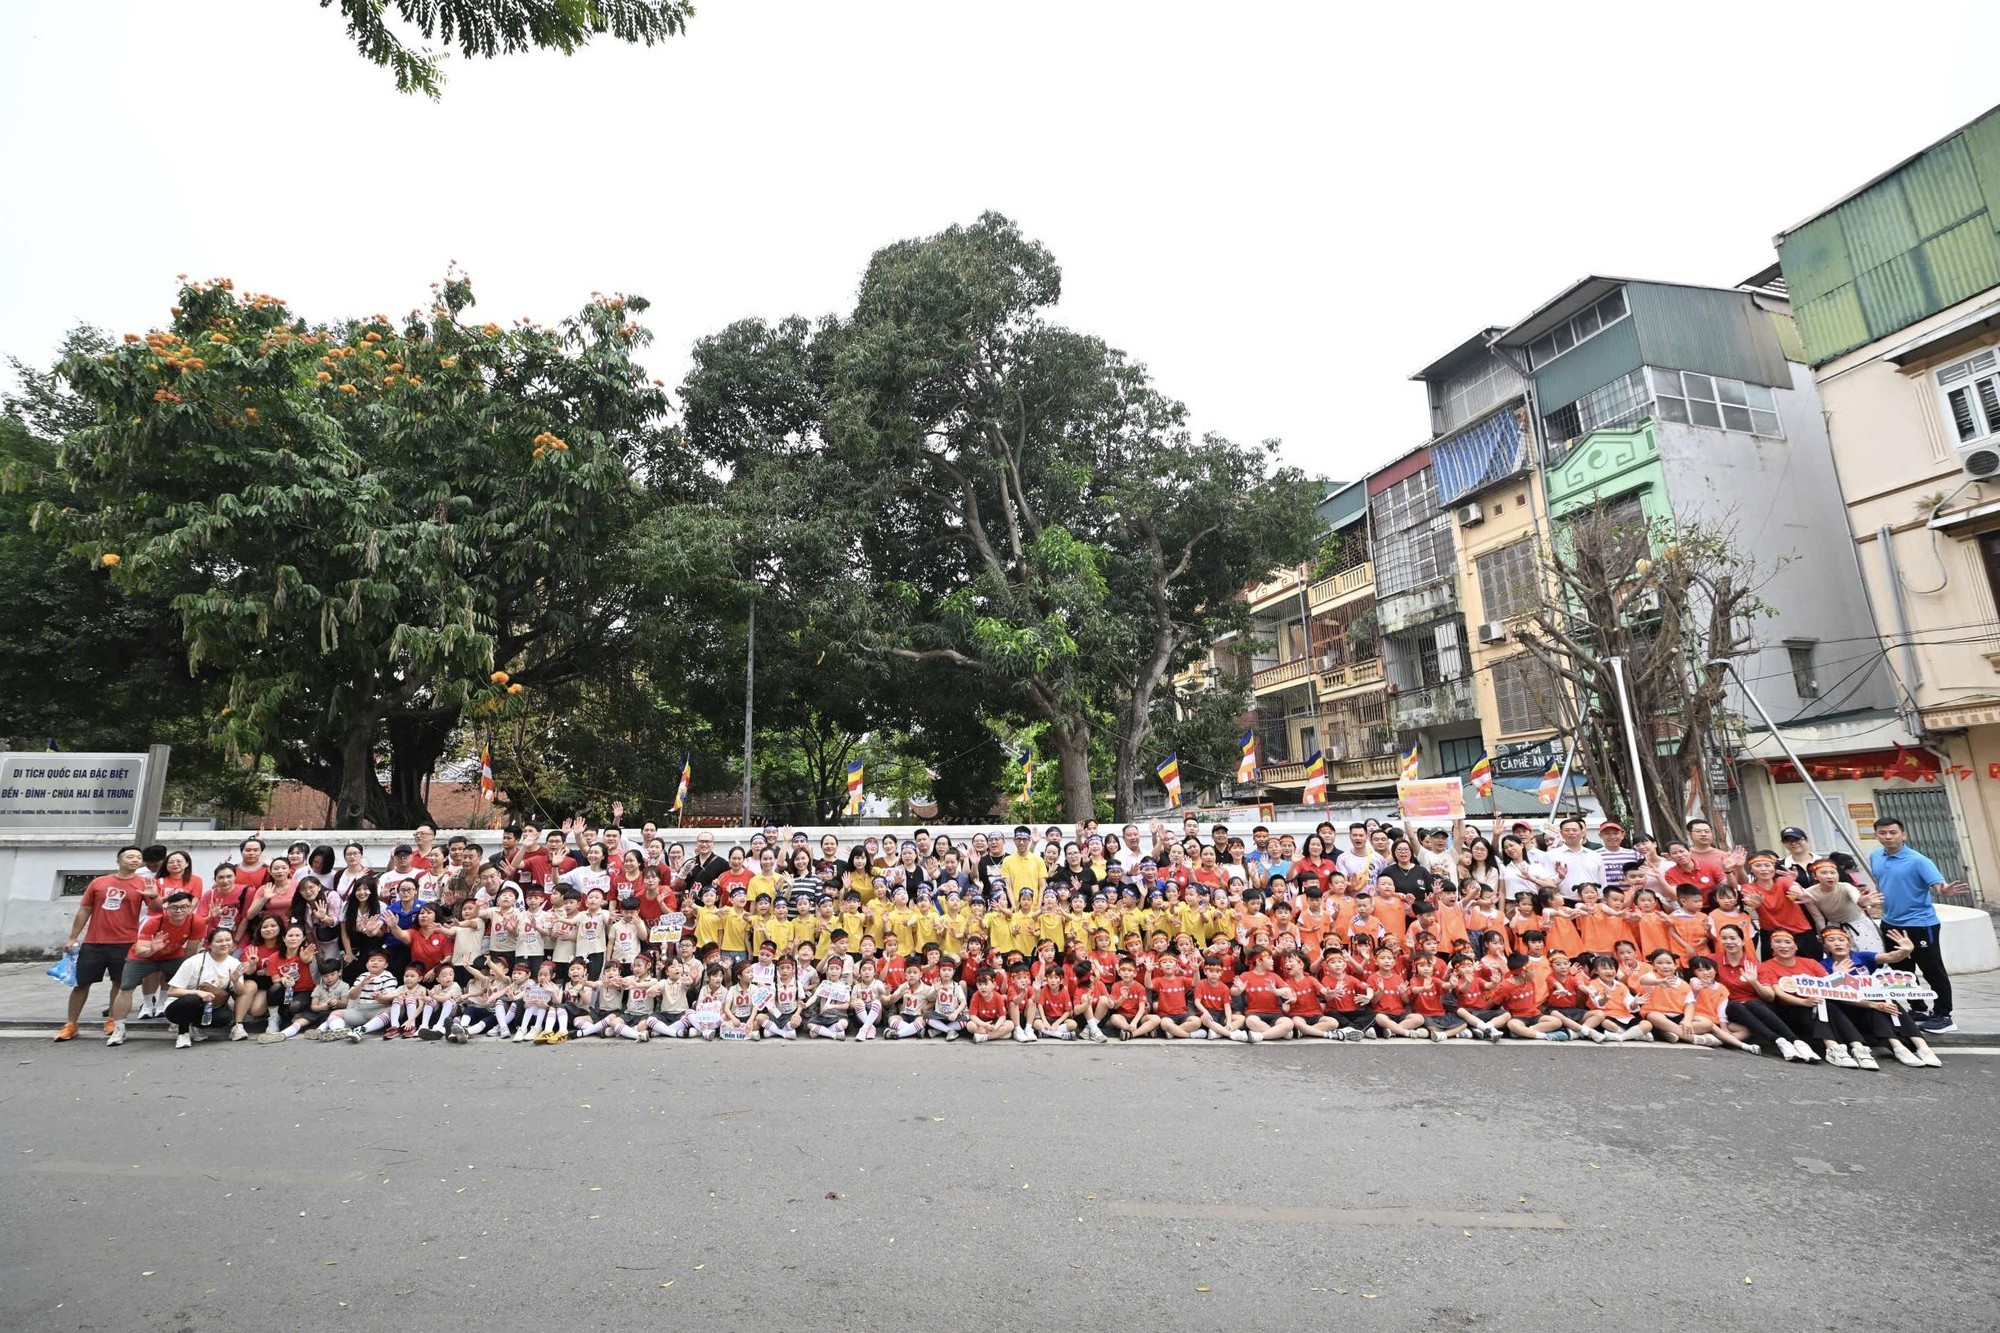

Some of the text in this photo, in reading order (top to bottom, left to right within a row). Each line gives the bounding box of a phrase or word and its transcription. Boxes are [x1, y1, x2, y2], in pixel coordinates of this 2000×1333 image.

[13, 766, 129, 780] DI TÍCH QUỐC GIA ĐẶC BIỆT
[76, 789, 91, 798] HAI
[93, 787, 104, 798] BÀ
[106, 788, 134, 798] TRƯNG
[633, 989, 647, 1000] D1
[780, 992, 793, 1002] D1
[861, 990, 874, 1001] D1
[939, 992, 953, 1002] D1
[736, 996, 749, 1005] D1
[906, 997, 918, 1008] D1
